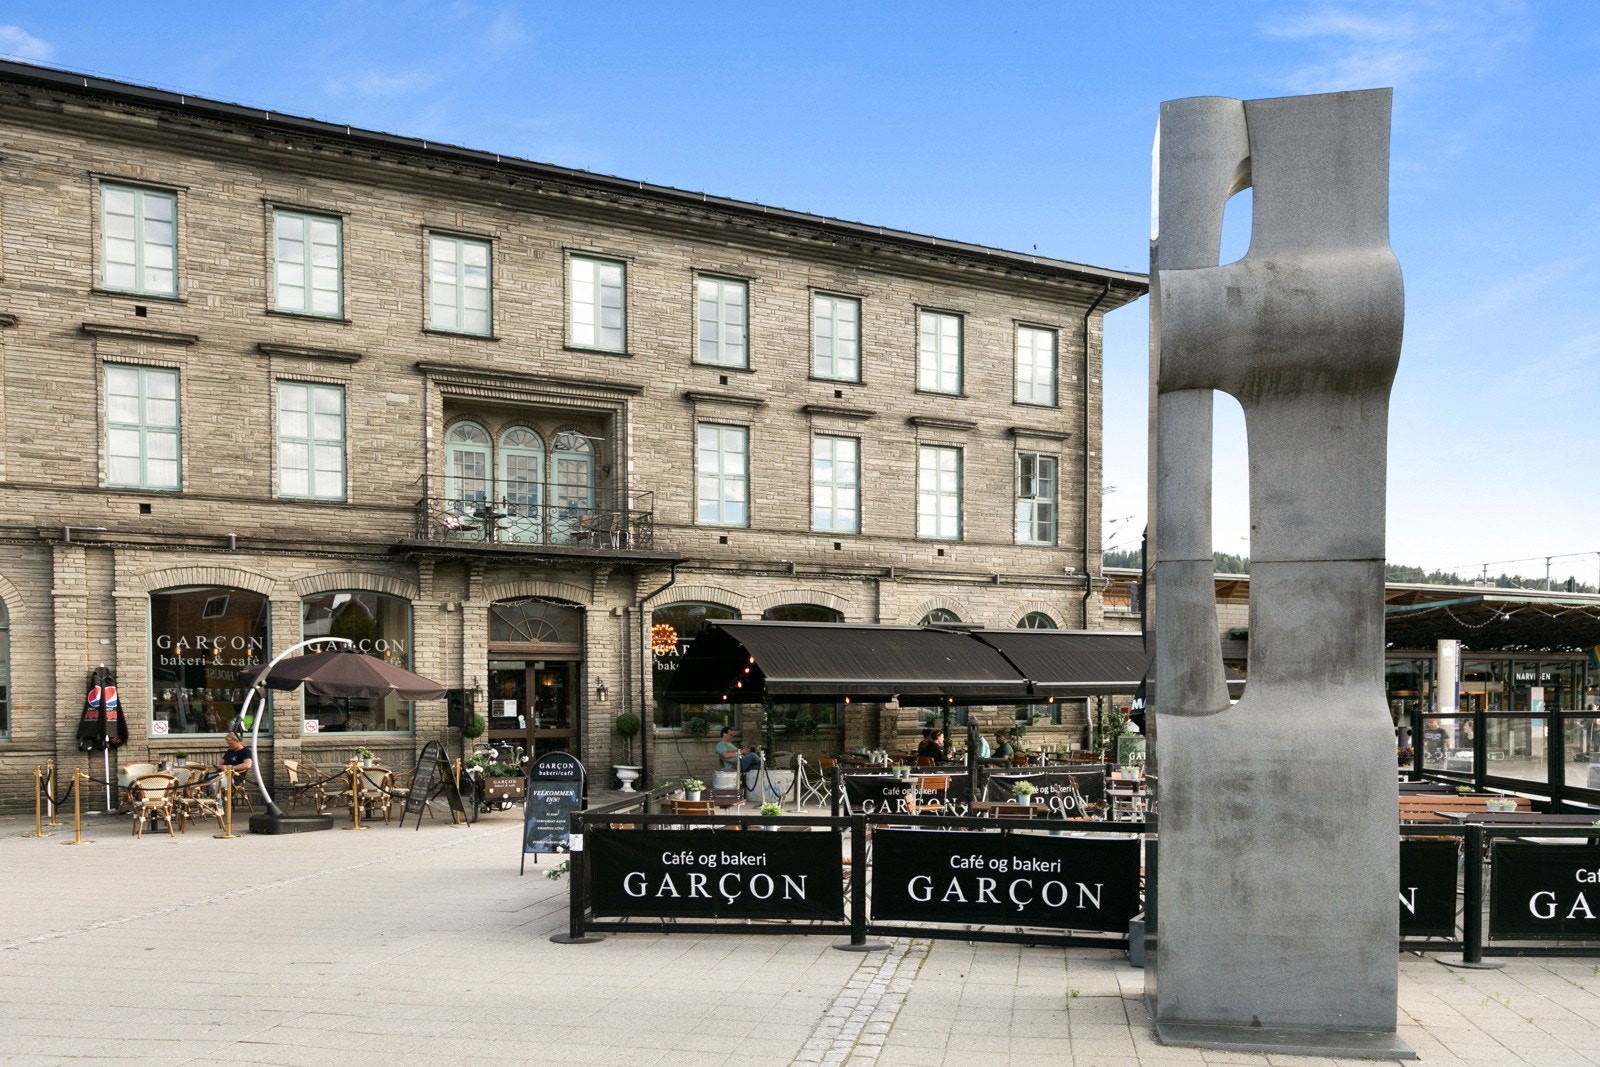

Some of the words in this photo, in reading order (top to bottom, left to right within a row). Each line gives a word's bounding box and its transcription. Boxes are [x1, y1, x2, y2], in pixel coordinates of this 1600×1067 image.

[156, 634, 264, 653] GARÇON
[307, 638, 405, 654] GAÇON
[160, 654, 206, 666] bakeri
[212, 655, 224, 666] &
[657, 660, 680, 671] bak
[1516, 672, 1551, 681] NARVEN
[539, 762, 574, 771] GARÇON
[882, 787, 901, 796] Café
[1039, 786, 1049, 795] og
[661, 851, 695, 865] Café
[698, 853, 717, 868] og
[721, 851, 767, 866] bakeri
[950, 854, 985, 869] Café
[988, 858, 1009, 873] og
[1013, 856, 1062, 873] bakeri
[623, 871, 808, 904] GARÇON
[907, 875, 1104, 911] GARÇON
